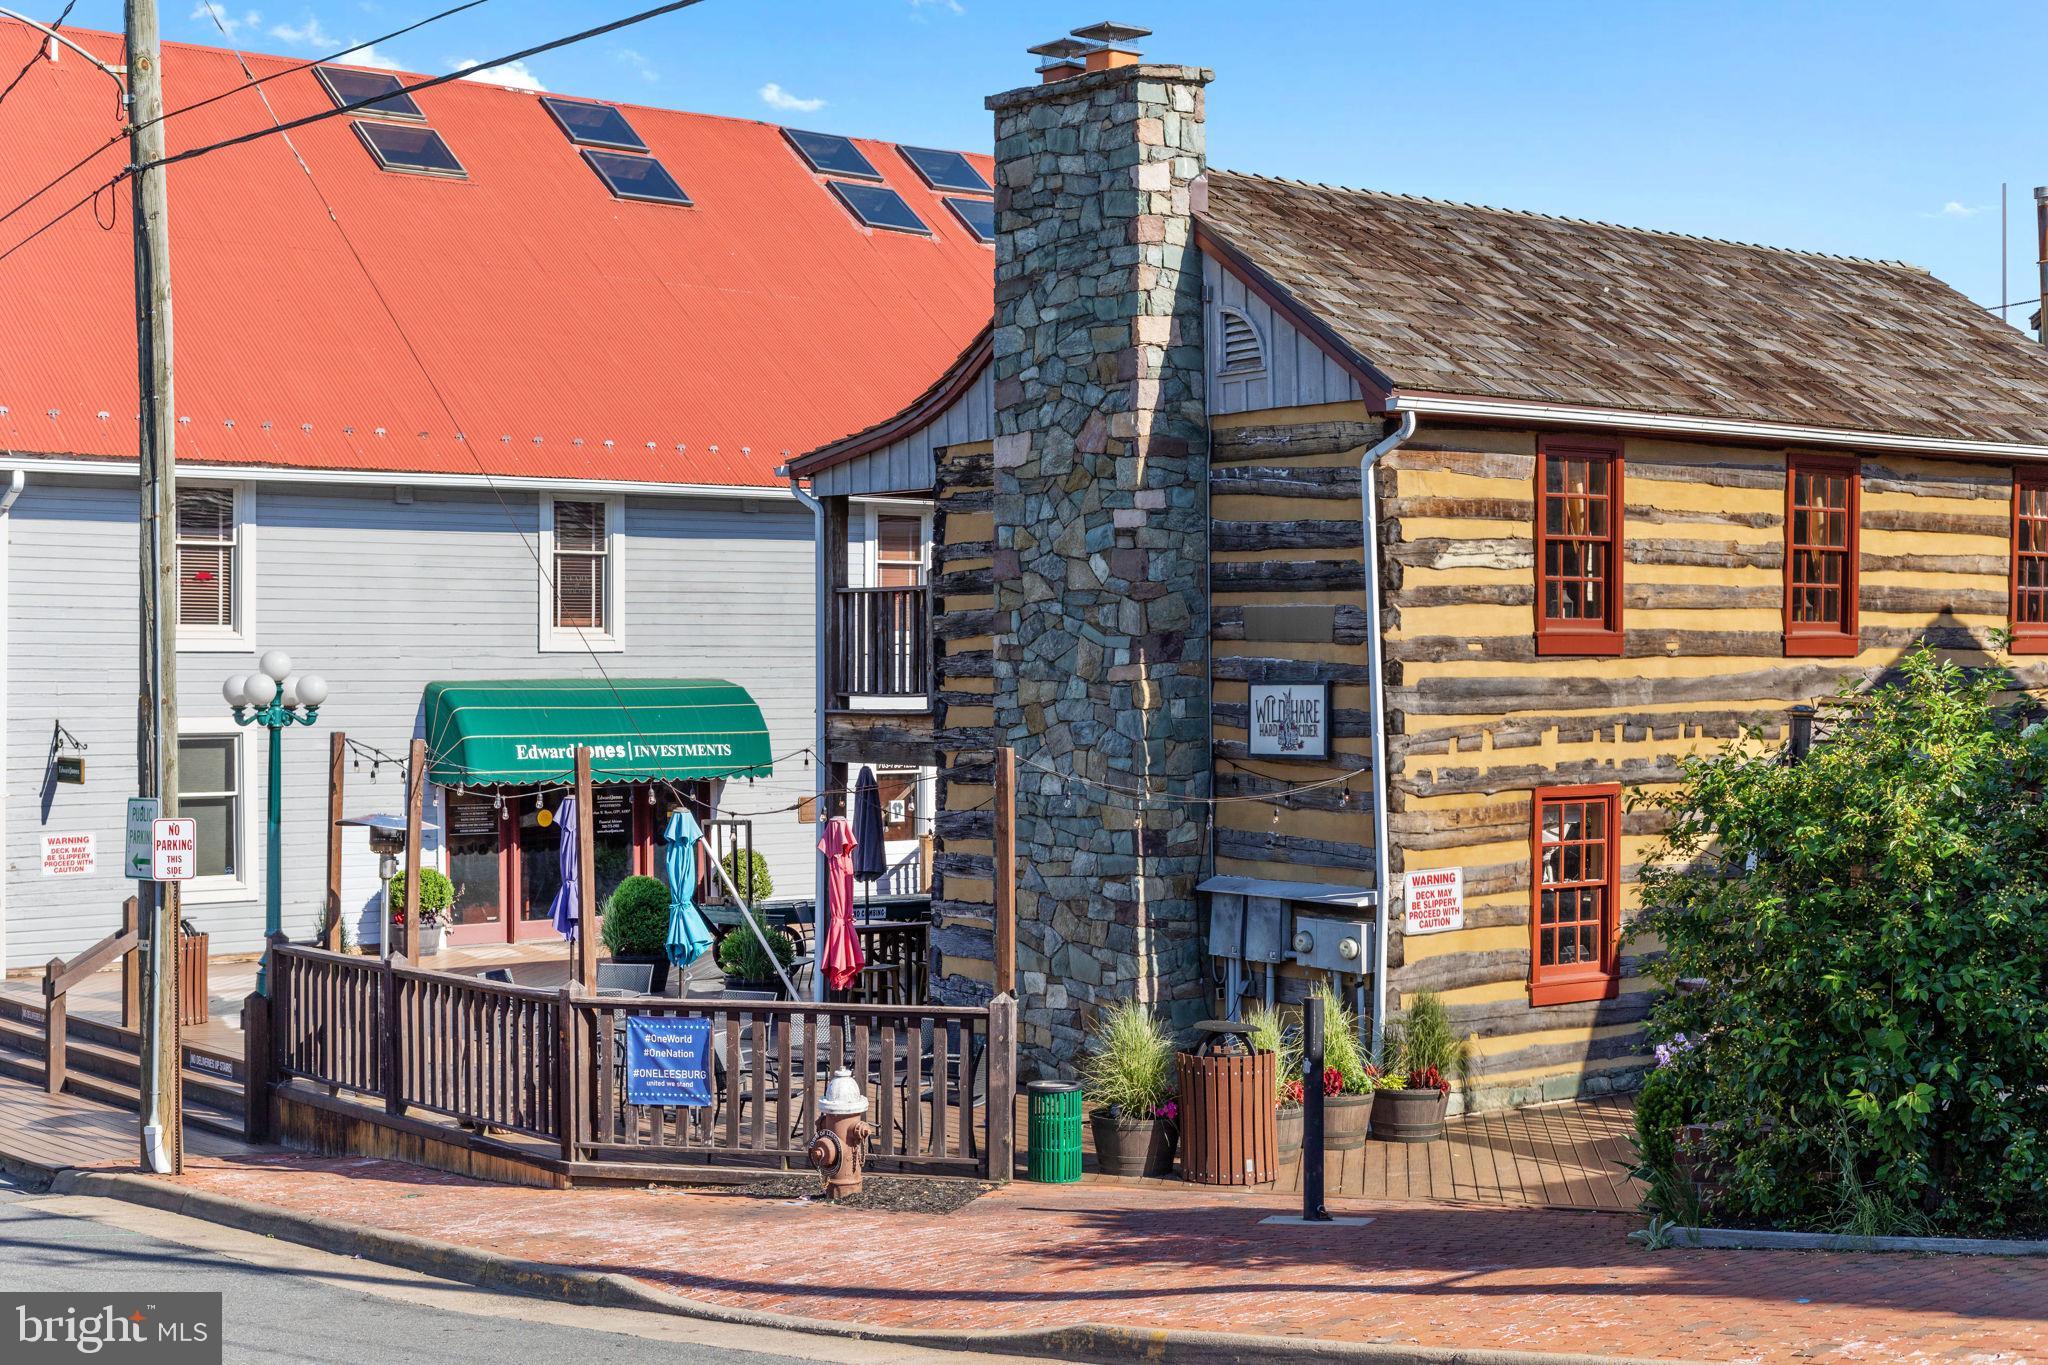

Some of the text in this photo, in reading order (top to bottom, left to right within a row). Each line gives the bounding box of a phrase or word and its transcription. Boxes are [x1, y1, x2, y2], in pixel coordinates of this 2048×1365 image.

[1255, 695, 1320, 723] WILD HARE
[1259, 723, 1318, 737] HARD CIDER
[634, 743, 732, 757] INVESTMENTS
[132, 807, 153, 822] PUBLIC
[168, 824, 180, 836] NO
[47, 836, 90, 845] WARNING
[156, 839, 193, 851] PARKING
[166, 855, 182, 863] THIS
[166, 866, 182, 875] SIDE
[1412, 873, 1456, 886] WARNING
[1415, 889, 1453, 900] DECK MAY
[1411, 897, 1457, 911] BE SLIPPERY
[1409, 906, 1460, 920] PROCEED WITH
[1419, 917, 1451, 928] CAUTION
[645, 1034, 692, 1044] #OneWorld
[643, 1048, 694, 1058] #OneNation
[632, 1069, 707, 1080] #ONELEESBURG
